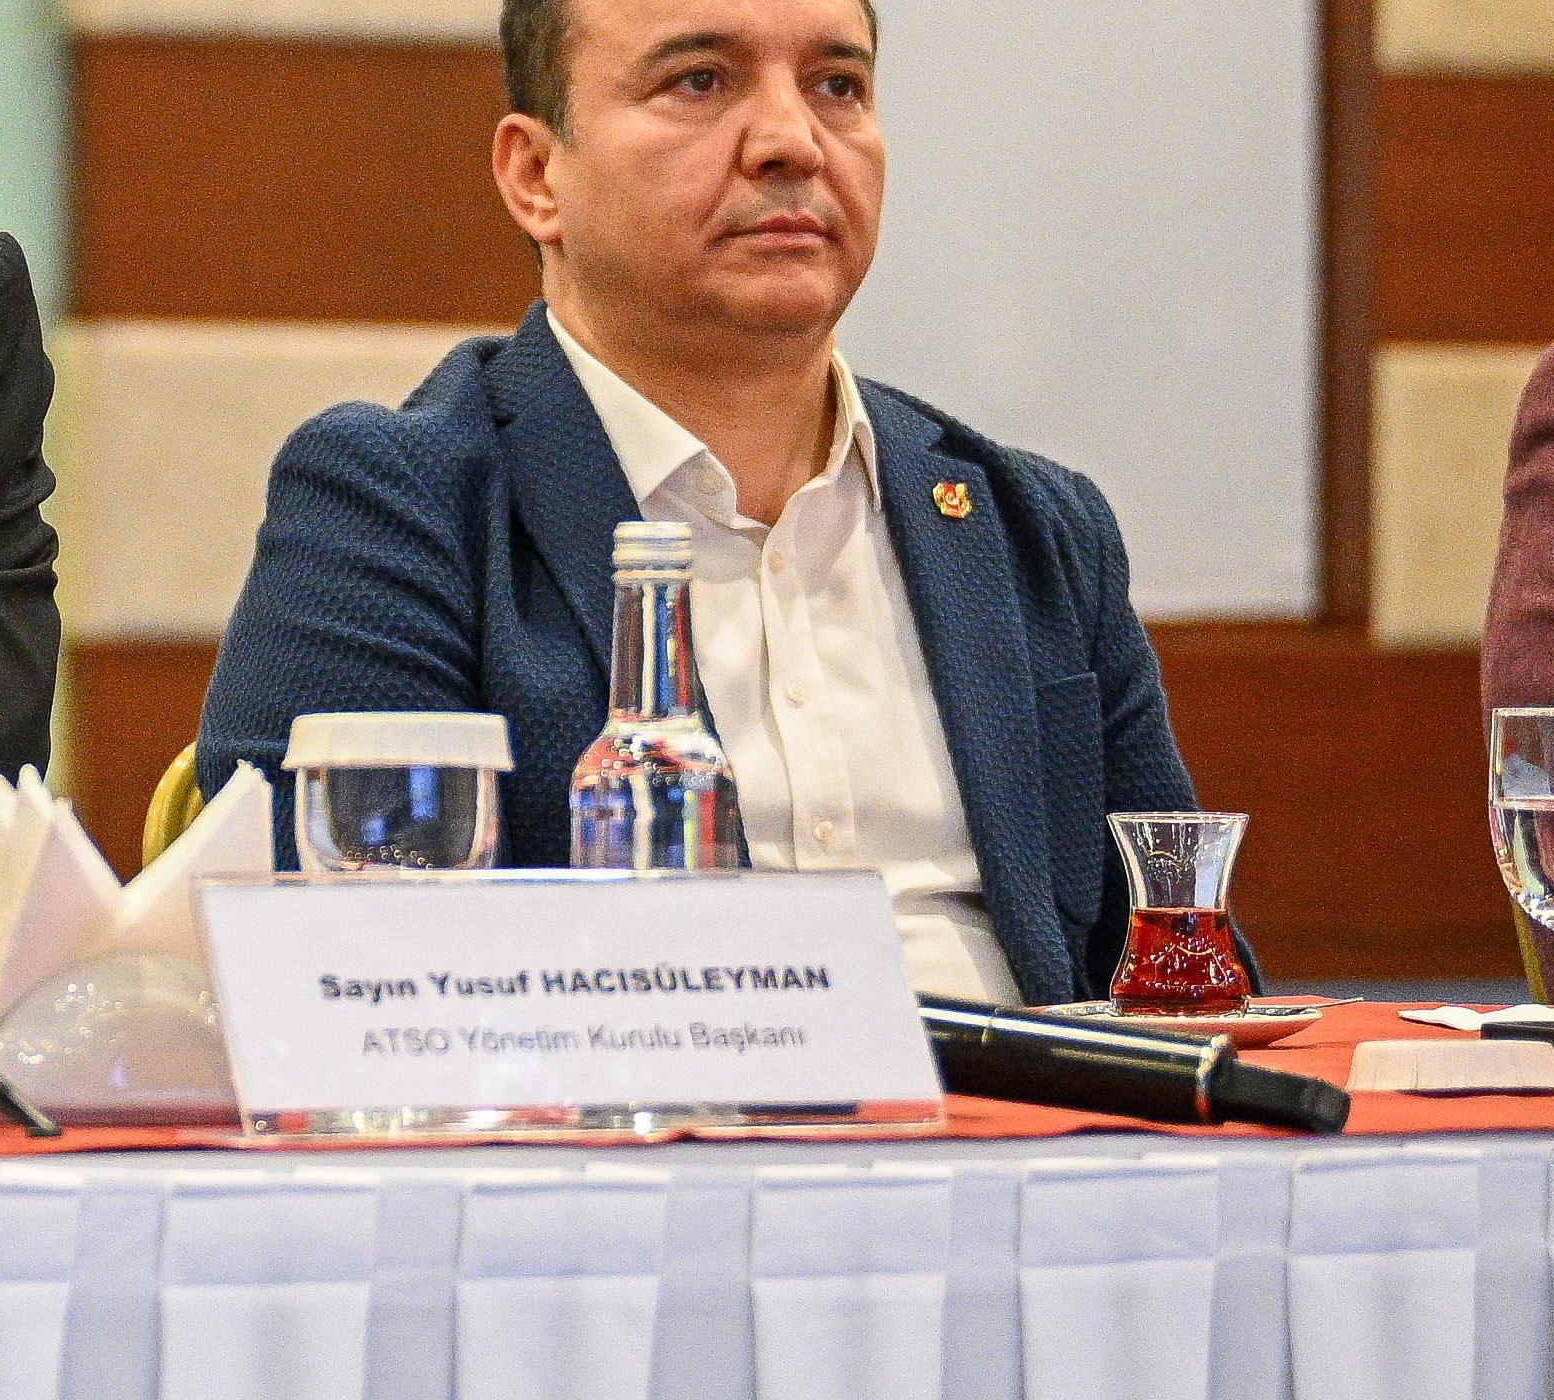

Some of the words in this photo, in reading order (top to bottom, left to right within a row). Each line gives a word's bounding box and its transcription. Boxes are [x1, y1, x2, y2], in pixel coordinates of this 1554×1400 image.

[318, 972, 419, 1006] Sayın
[427, 969, 532, 999] Yusuf
[539, 962, 834, 997] HACISÜLEYMAN
[360, 1025, 452, 1057] ATSO
[456, 1022, 581, 1054] Yönetim
[585, 1020, 684, 1051] Kurulu
